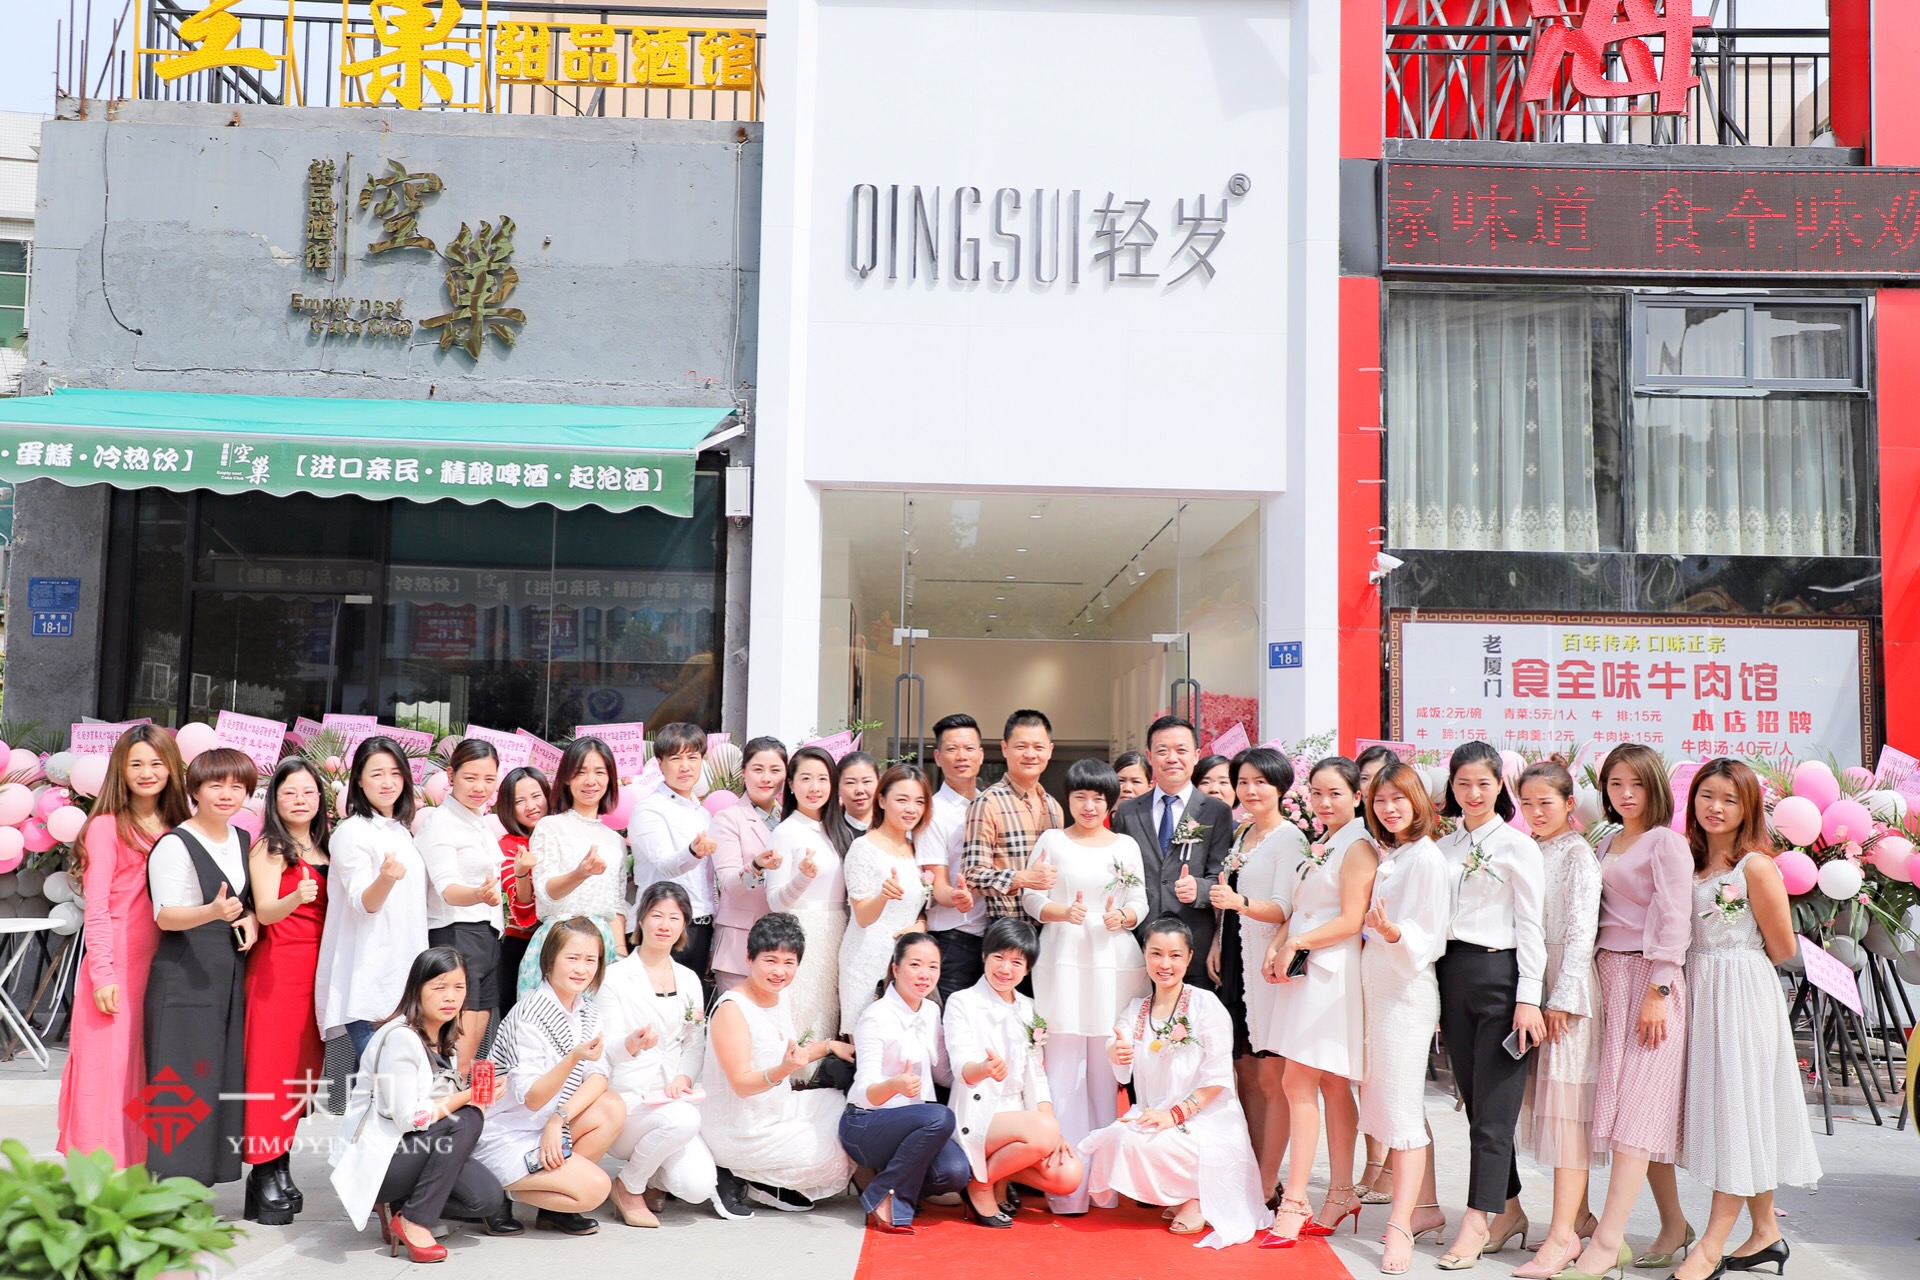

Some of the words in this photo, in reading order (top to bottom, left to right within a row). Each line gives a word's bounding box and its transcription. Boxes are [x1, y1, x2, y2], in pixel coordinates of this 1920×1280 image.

[495, 24, 756, 86] 甜品酒馆
[851, 183, 1081, 284] QINGSUI
[1094, 192, 1228, 287] 轻岁
[42, 621, 61, 633] 18-1
[1561, 633, 1640, 653] 百年传承
[1646, 634, 1726, 654] 口味正宗
[1278, 652, 1292, 665] 18
[1482, 634, 1503, 698] 老厦门
[1511, 659, 1779, 702] 食全味牛肉馆
[1692, 709, 1813, 734] 本店招牌
